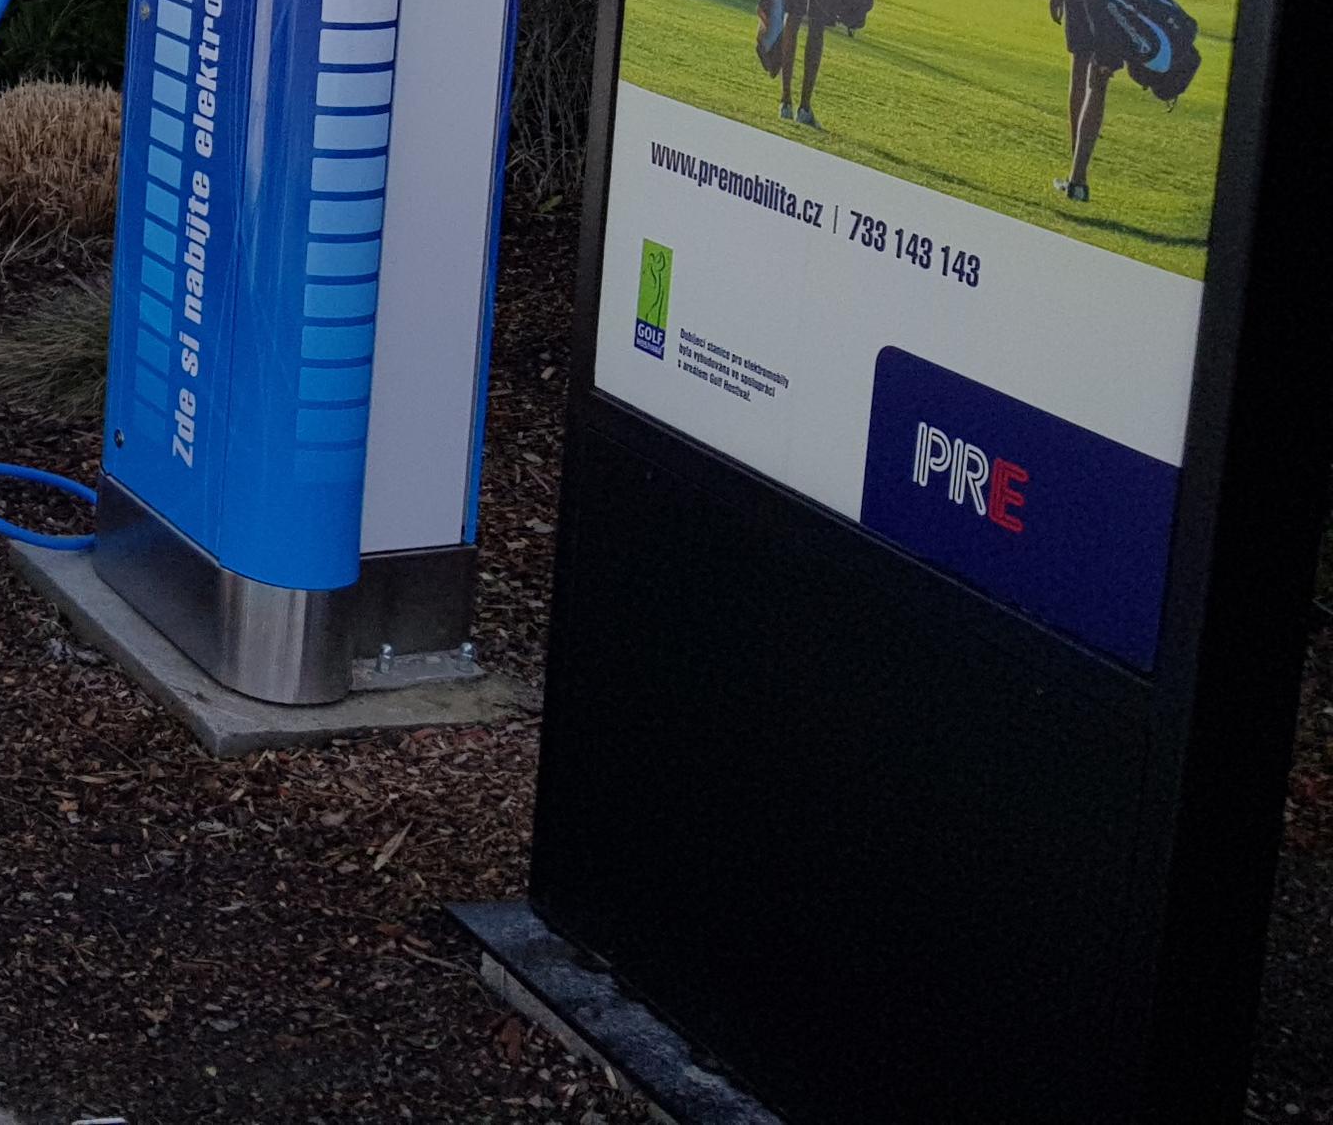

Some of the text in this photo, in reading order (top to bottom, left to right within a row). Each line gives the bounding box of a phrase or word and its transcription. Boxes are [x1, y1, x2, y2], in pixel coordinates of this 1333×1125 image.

[183, 170, 212, 326] nabijte
[650, 141, 981, 288] www.premobilita.cz 733 143 143
[179, 331, 200, 378] si
[637, 323, 664, 346] GOLF
[172, 387, 197, 469] Zde
[913, 421, 1030, 534] PRE
